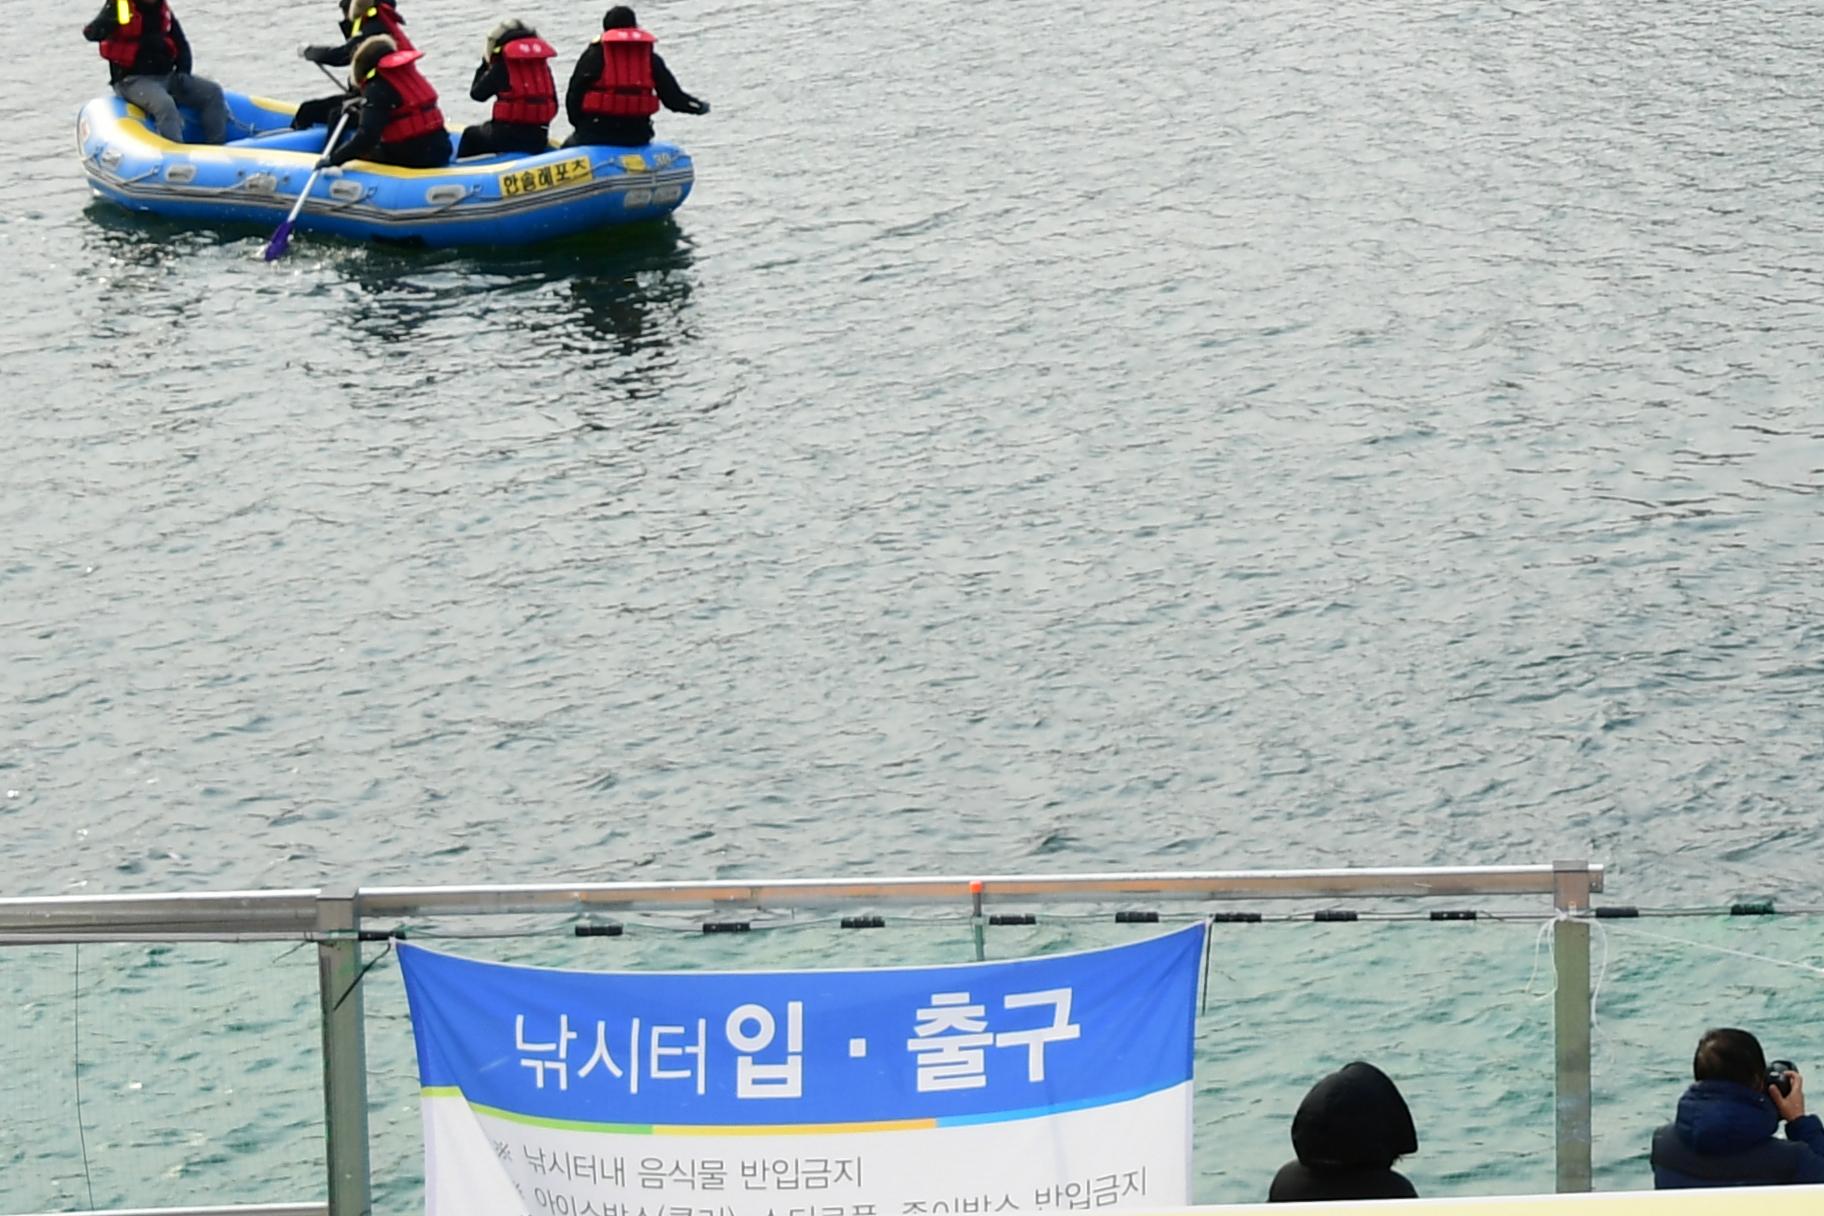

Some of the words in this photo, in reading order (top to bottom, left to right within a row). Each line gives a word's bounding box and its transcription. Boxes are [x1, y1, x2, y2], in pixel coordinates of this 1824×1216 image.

[514, 1012, 706, 1095] 낚시터
[724, 1000, 802, 1100] 입
[906, 986, 1081, 1094] 출구
[522, 1143, 626, 1185] 낚시터내
[637, 1156, 729, 1190] 음식물
[741, 1155, 863, 1190] 반입금지
[1034, 1166, 1147, 1211] 반입금지
